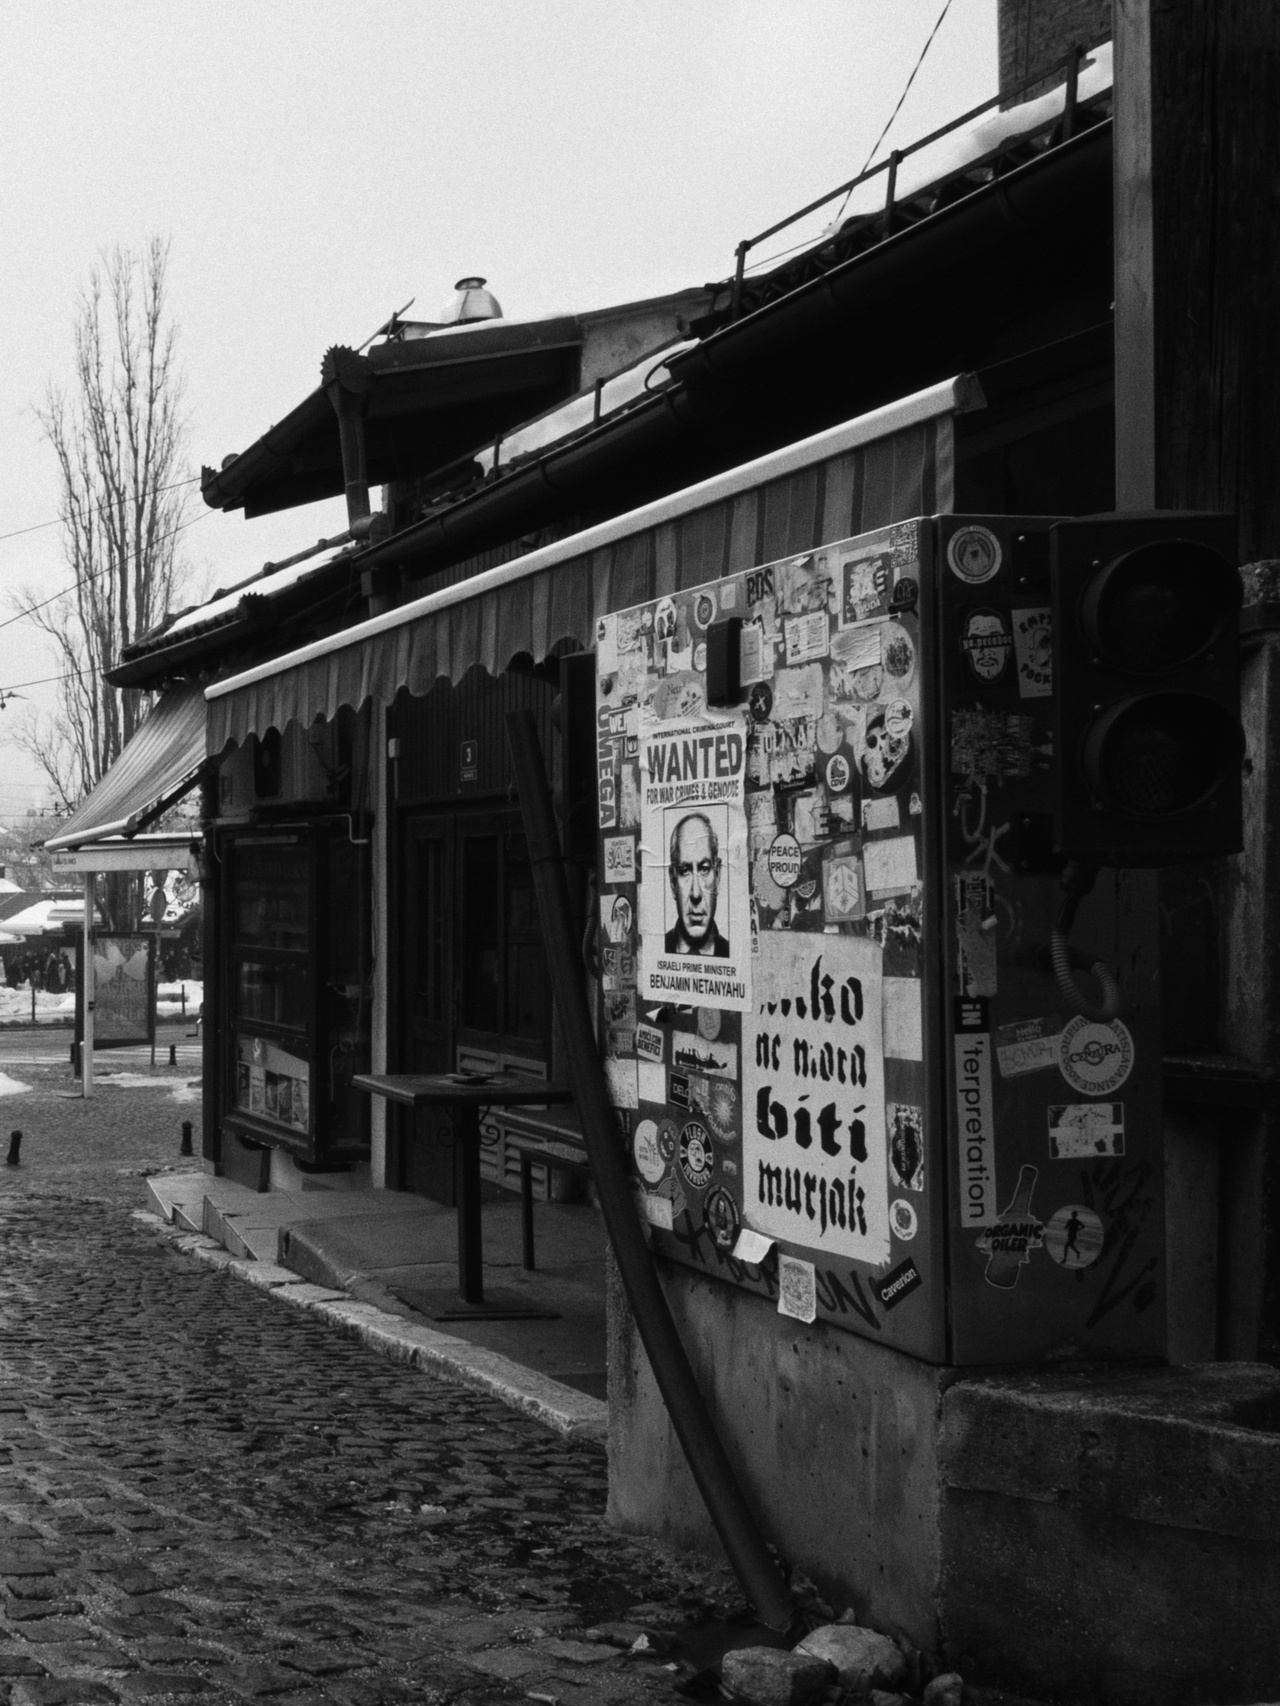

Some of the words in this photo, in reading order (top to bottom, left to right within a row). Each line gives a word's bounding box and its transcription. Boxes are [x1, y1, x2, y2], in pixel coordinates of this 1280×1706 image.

[652, 727, 691, 740] INTERNATIONAL
[647, 734, 742, 784] WANTED
[647, 788, 659, 804] FOR
[660, 786, 674, 803] WAR
[675, 783, 699, 802] CRIMES
[771, 846, 799, 858] PEACE
[771, 862, 800, 874] PROUD
[656, 960, 681, 972] ISRAELI
[682, 963, 703, 975] PRIME
[704, 965, 736, 978] MINISTER
[649, 974, 691, 993] BENJAMIN
[693, 978, 746, 999] NETANYAHU
[1016, 1025, 1042, 1037] Hello
[1070, 1043, 1121, 1064] CENZURA
[1081, 1077, 1117, 1092] SINCE
[757, 1086, 868, 1164] biti
[958, 1040, 990, 1219] 'terpretation
[758, 1159, 867, 1238] murjak
[984, 1223, 1043, 1240] ORGANIC
[992, 1238, 1028, 1252] OILER
[881, 1271, 917, 1301] Caverion
